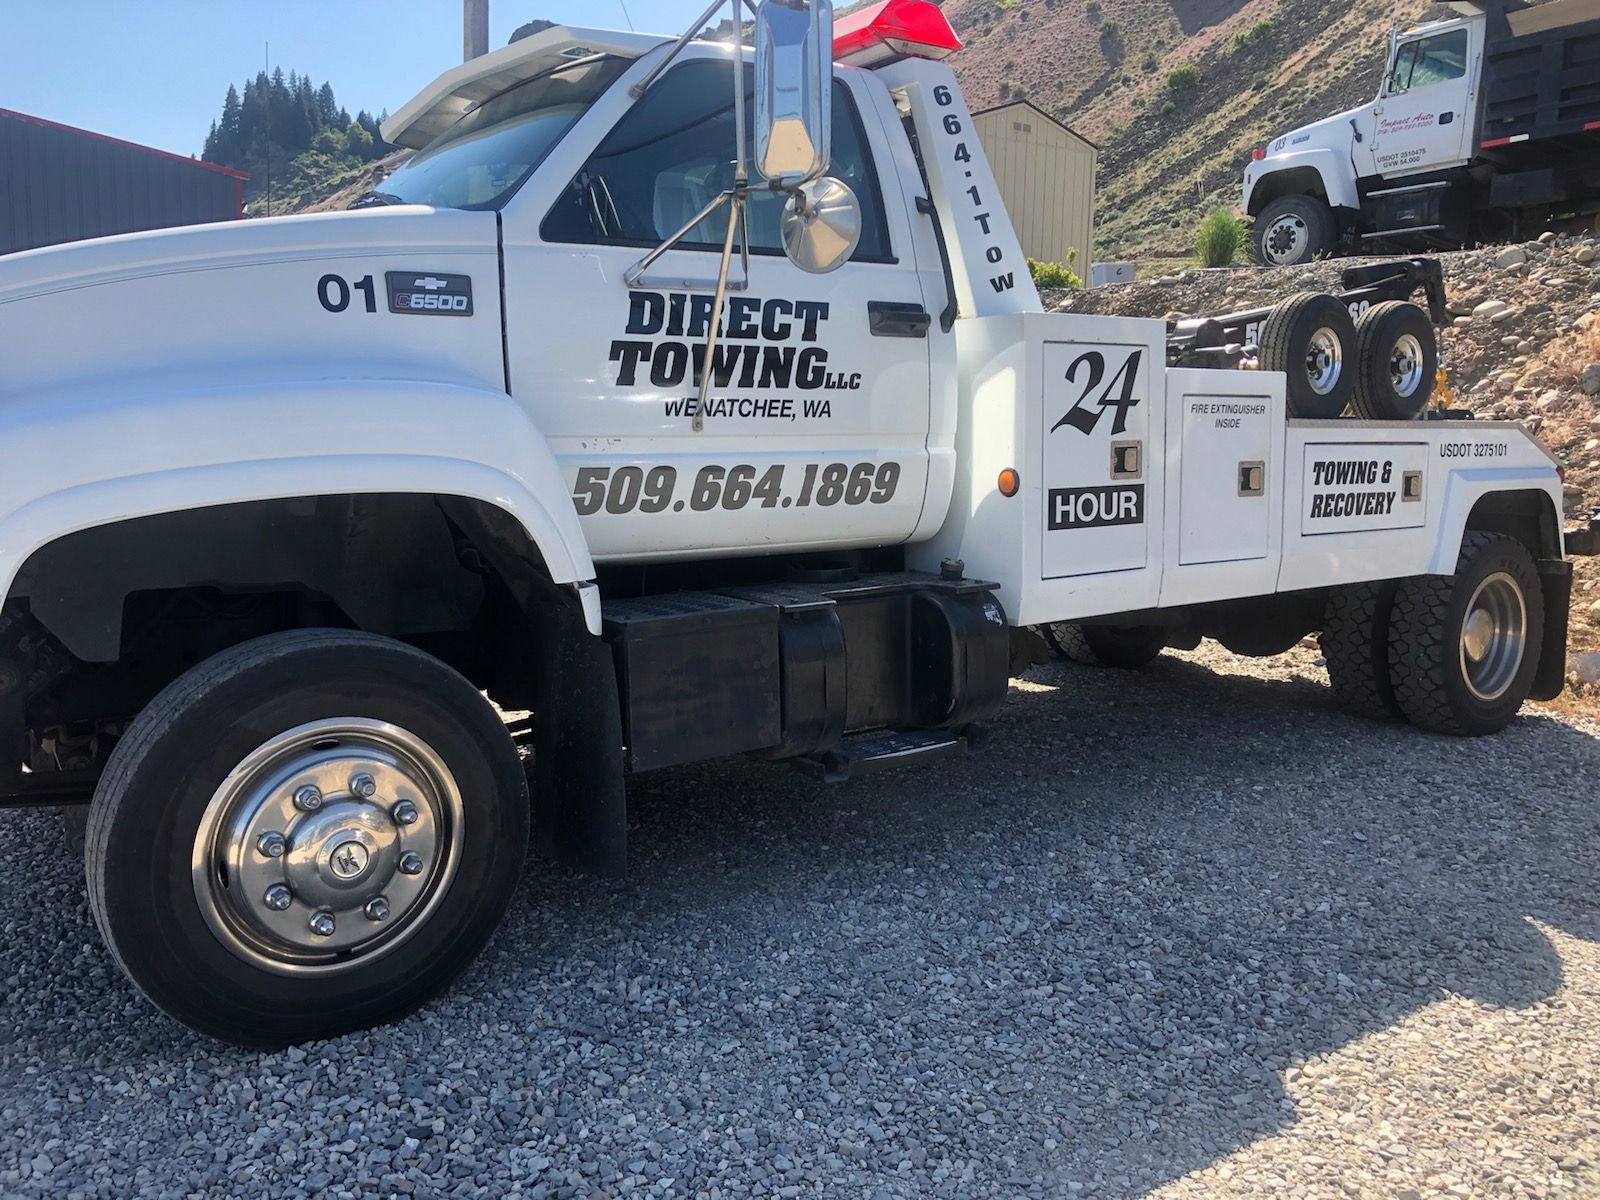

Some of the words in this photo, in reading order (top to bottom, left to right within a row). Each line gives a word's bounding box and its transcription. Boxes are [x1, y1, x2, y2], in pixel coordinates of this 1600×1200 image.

[1412, 113, 1434, 123] Auto
[1377, 153, 1399, 163] USDOT
[1382, 160, 1399, 168] GVW
[317, 274, 376, 313] 01
[395, 292, 467, 310] C6500
[625, 291, 829, 341] DIRECT
[608, 340, 828, 389] TOWING
[824, 372, 861, 390] LLC
[1051, 350, 1142, 435] 24
[664, 398, 796, 421] WENATCHEE,
[803, 400, 831, 418] WA
[1191, 404, 1209, 414] FIRE
[1210, 404, 1265, 414] EXTINGUISHER
[1215, 418, 1240, 428] INSIDE
[1440, 443, 1472, 457] USDOT
[1474, 443, 1507, 456] 3275101
[1313, 461, 1377, 485] TOWING
[1381, 460, 1392, 483] &
[572, 461, 901, 515] 509.664.1869
[1055, 491, 1137, 523] HOUR
[1310, 491, 1396, 518] RECOVERY
